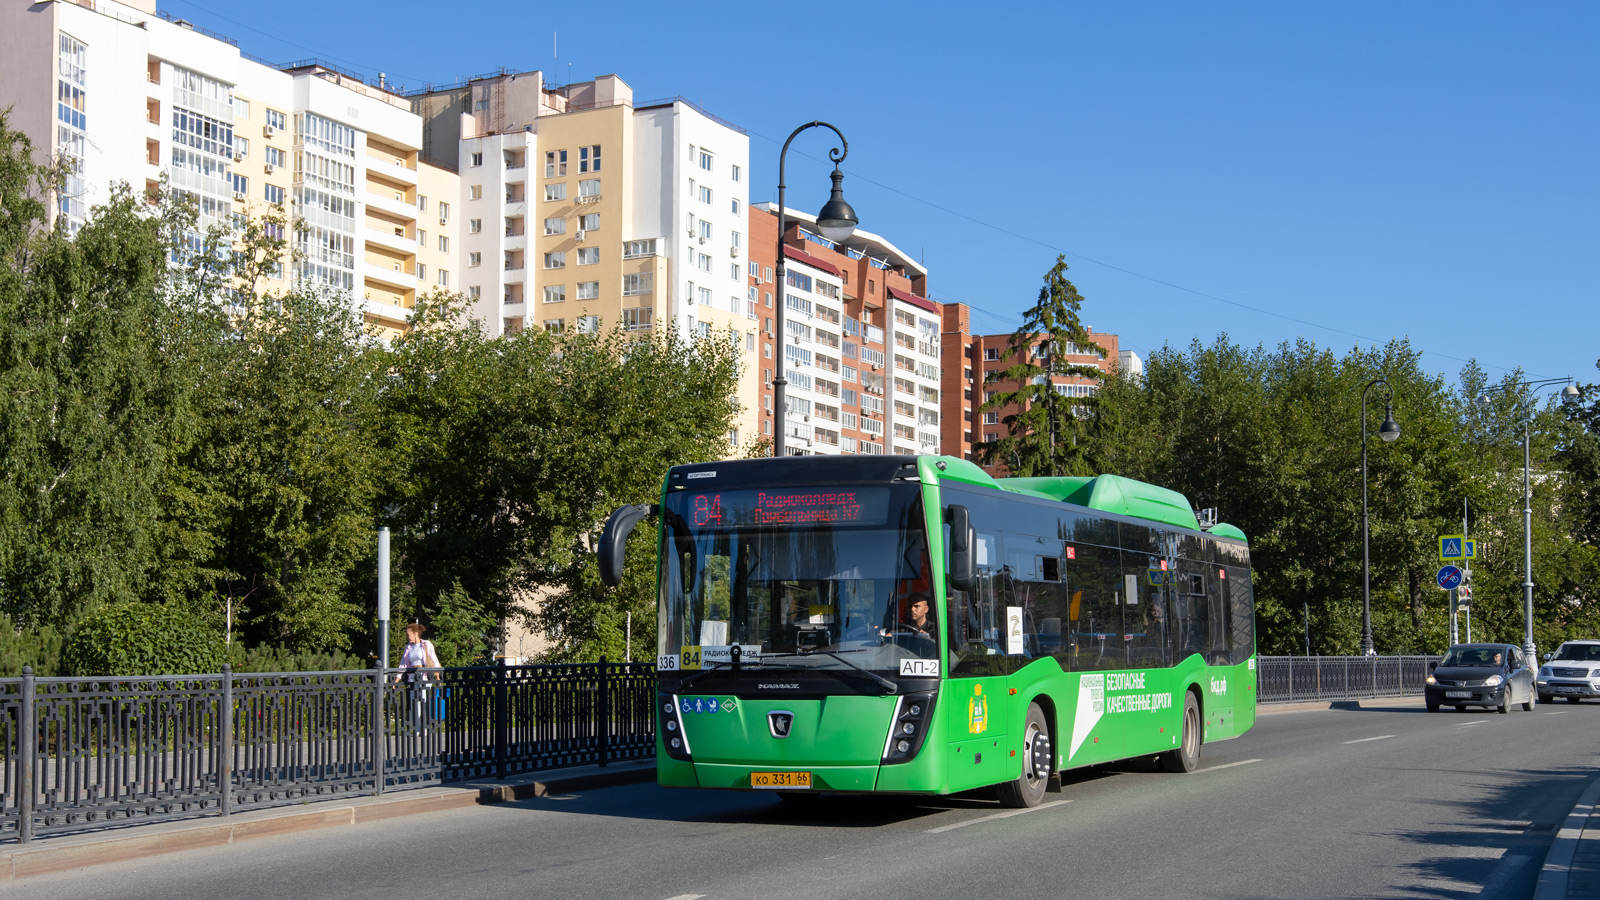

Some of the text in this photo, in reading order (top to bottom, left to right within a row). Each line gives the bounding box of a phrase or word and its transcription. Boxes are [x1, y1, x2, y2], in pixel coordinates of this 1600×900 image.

[694, 494, 722, 526] 84
[659, 656, 675, 669] 336
[682, 651, 700, 666] 84
[902, 661, 938, 674] АП-2
[1106, 672, 1146, 691] БЕЗОПАСНЫЕ
[1106, 693, 1151, 714] КАЧЕСТВЕННЫЕ
[1151, 692, 1172, 713] ДОРОГИ
[772, 773, 791, 785] 331
[797, 773, 808, 782] 66
